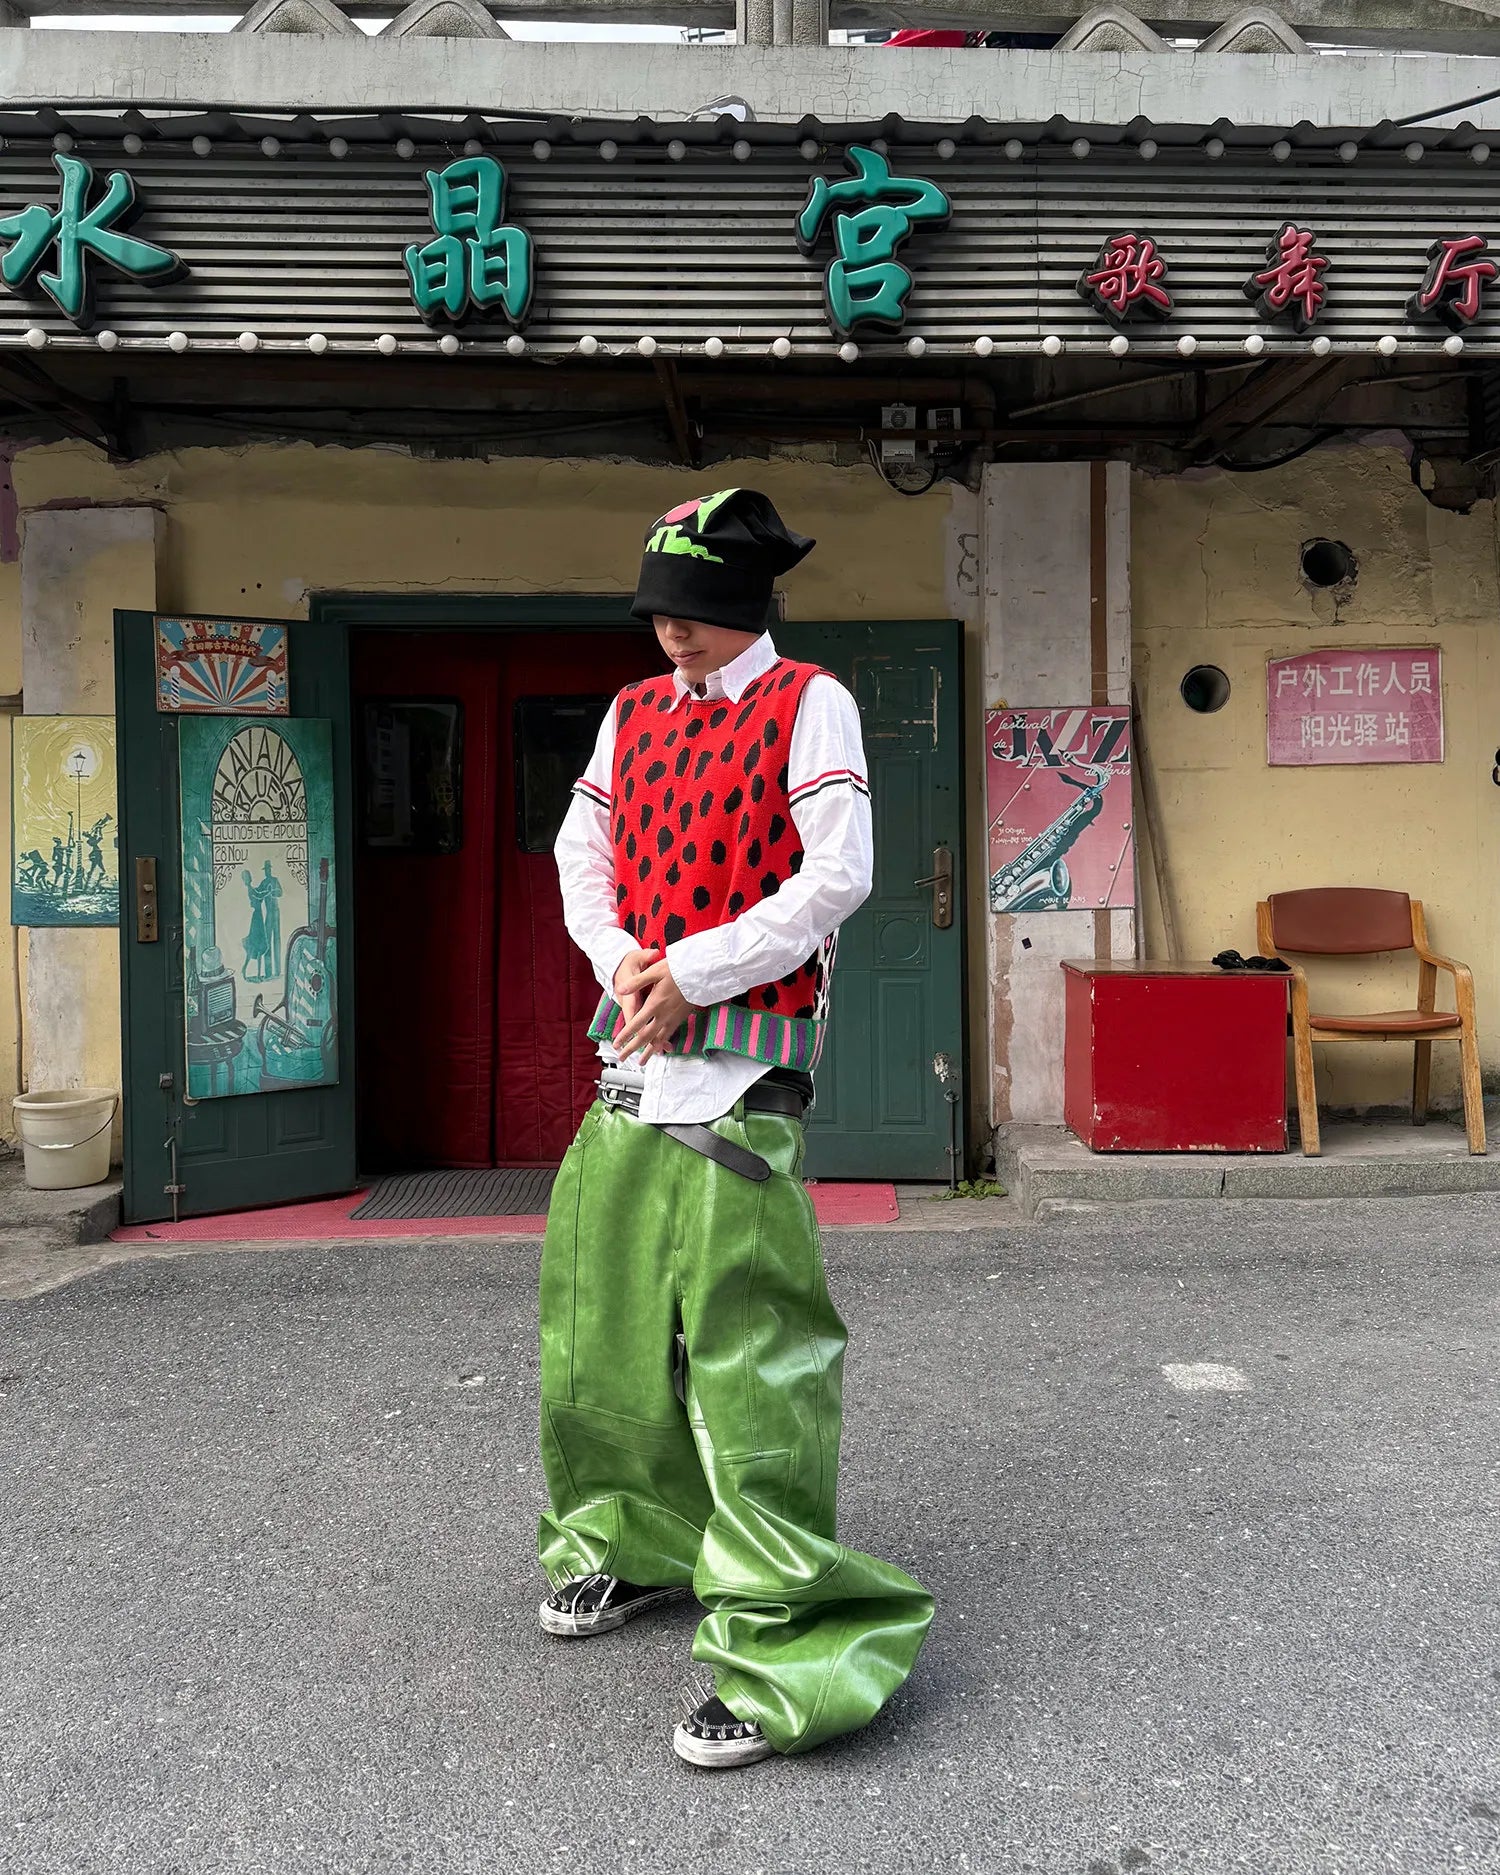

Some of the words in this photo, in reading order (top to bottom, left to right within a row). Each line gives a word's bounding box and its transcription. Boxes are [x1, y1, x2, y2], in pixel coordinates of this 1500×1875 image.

[0, 146, 951, 333] 水晶宫
[1086, 226, 1498, 321] 歌舞厅
[1275, 661, 1432, 698] 户外工作人员
[992, 710, 1130, 769] JAZZ
[1301, 712, 1410, 748] 阳光驿站
[236, 771, 287, 813] BLUES
